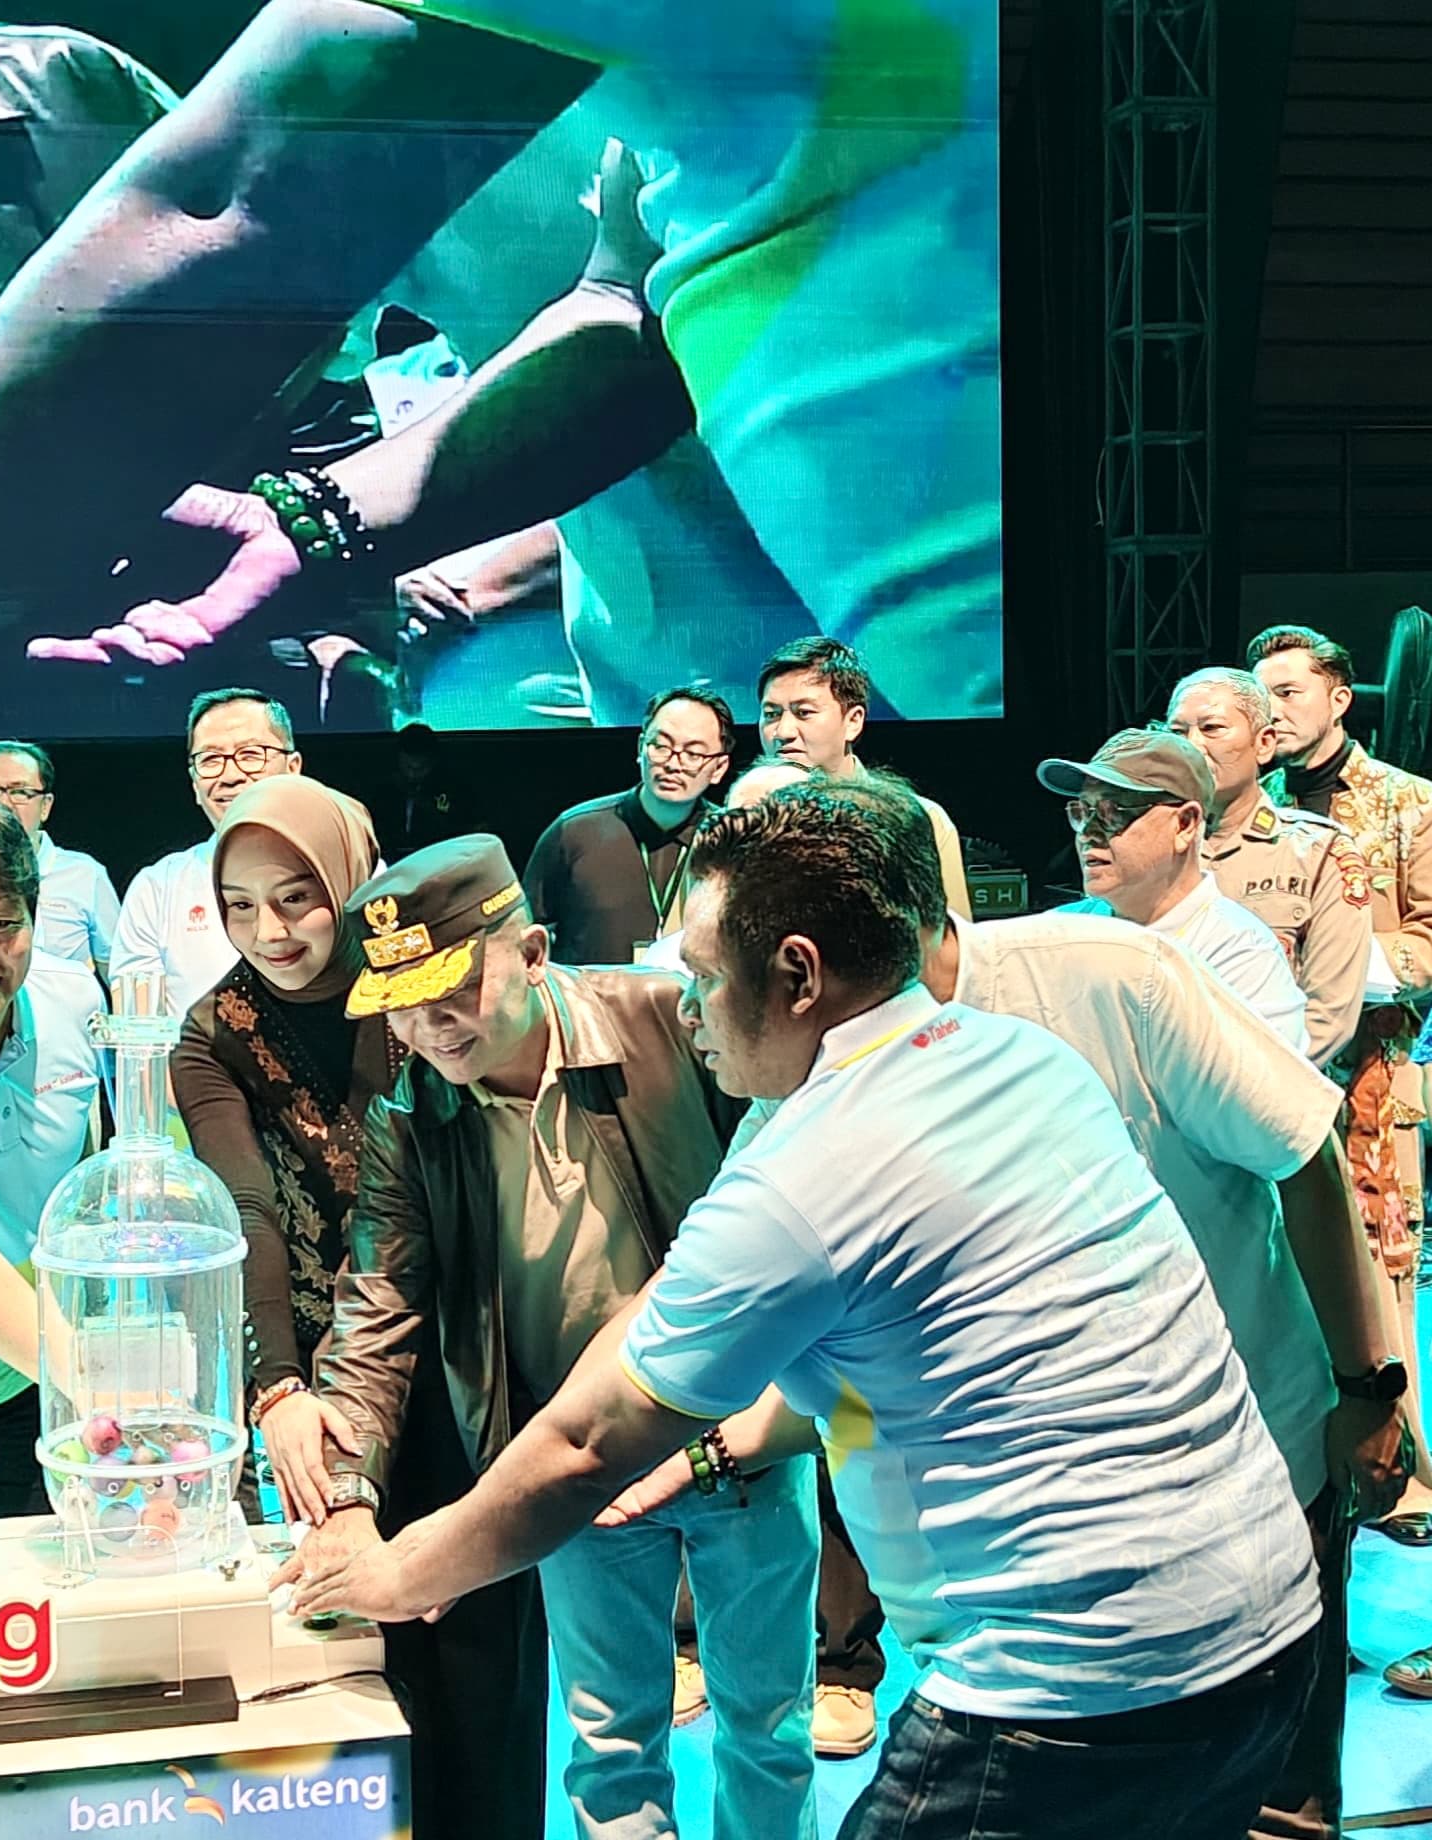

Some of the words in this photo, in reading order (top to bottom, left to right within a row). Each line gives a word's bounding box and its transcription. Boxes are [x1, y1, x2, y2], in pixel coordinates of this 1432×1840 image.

[1246, 875, 1308, 897] POLRI
[70, 1788, 176, 1831] bank
[232, 1774, 387, 1815] kalteng
